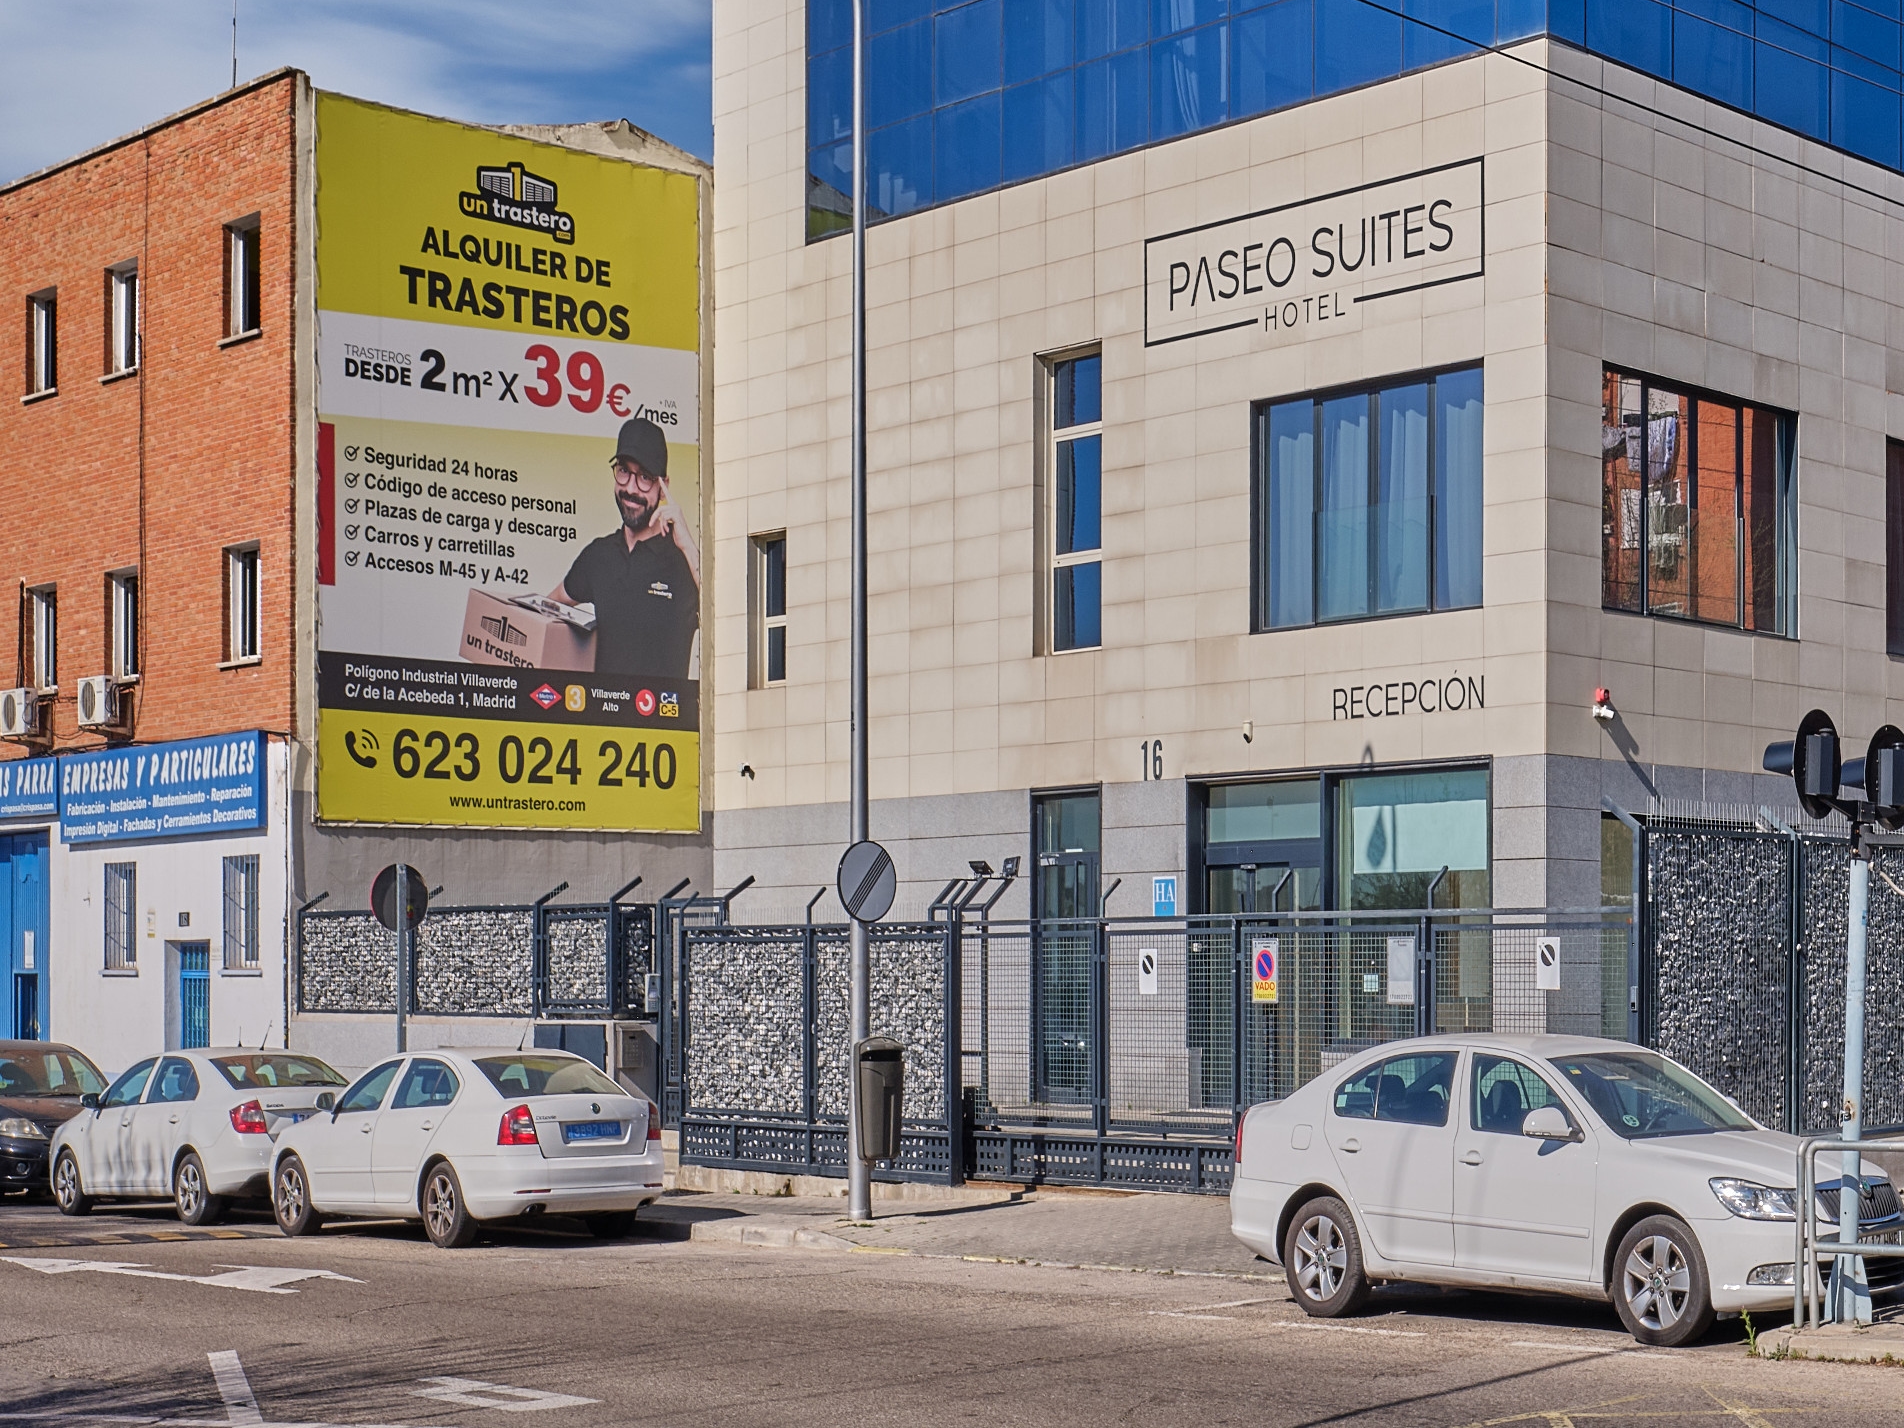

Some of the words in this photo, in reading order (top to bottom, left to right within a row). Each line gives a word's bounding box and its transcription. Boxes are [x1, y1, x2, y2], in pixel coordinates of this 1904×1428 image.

[463, 197, 488, 215] un
[492, 198, 571, 231] trastero
[421, 226, 568, 280] ALQUILER
[575, 255, 611, 288] DE
[1170, 237, 1296, 312] PASEO
[1312, 199, 1453, 278] SUITES
[399, 265, 630, 341] TRASTEROS
[1265, 292, 1345, 332] HOTEL
[344, 343, 412, 366] TRASTEROS
[345, 357, 412, 387] DESDE
[364, 446, 446, 473] Seguridad
[451, 459, 469, 476] 24
[474, 462, 518, 482] horas
[364, 473, 422, 498] Código
[428, 482, 447, 499] de
[452, 488, 506, 506] acceso
[512, 495, 576, 514] personal
[365, 499, 417, 521] Plazas
[422, 507, 442, 524] de
[446, 513, 490, 532] carga
[495, 518, 503, 535] y
[508, 517, 577, 542] descarga
[365, 525, 419, 547] Carros
[424, 536, 433, 552] y
[438, 538, 515, 558] carretillas
[365, 552, 434, 574] Accesos
[439, 560, 476, 579] M-45
[481, 567, 490, 584] y
[494, 566, 529, 585] A-42
[466, 633, 482, 650] un
[345, 663, 399, 681] Polígono
[402, 668, 458, 685] Industrial
[461, 673, 518, 689] Villaverde
[345, 683, 360, 698] C/
[363, 685, 380, 699] de
[383, 686, 395, 700] la
[398, 687, 454, 705] Acebeda
[458, 692, 469, 708] 1,
[473, 693, 516, 709] Madrid
[569, 687, 581, 709] 3
[591, 688, 631, 700] Villaverde
[602, 702, 619, 712] Alto
[660, 692, 677, 704] C-4
[661, 705, 677, 715] C-5
[1333, 669, 1485, 721] RECEPCIÓN
[63, 757, 129, 795] EMPRESAS
[136, 755, 146, 788] Y
[149, 739, 255, 787] PARTICULARES
[393, 728, 480, 782] 623
[498, 735, 582, 785] 024
[598, 740, 677, 790] 240
[1141, 739, 1163, 781] 16
[16, 762, 54, 796] PARRA
[67, 800, 105, 816] Fabricación
[110, 796, 146, 812] Instalación
[152, 791, 205, 808] Mantenimiento
[211, 783, 252, 803] Reparación
[449, 796, 586, 812] www.untrastero.com
[64, 822, 96, 839] Impresión
[97, 820, 118, 837] Digital
[124, 817, 156, 832] Fachadas
[156, 819, 162, 832] y
[163, 812, 211, 828] Cerramientos
[213, 806, 257, 823] Decorativos
[1155, 883, 1175, 902] HA
[1255, 981, 1275, 991] VADO
